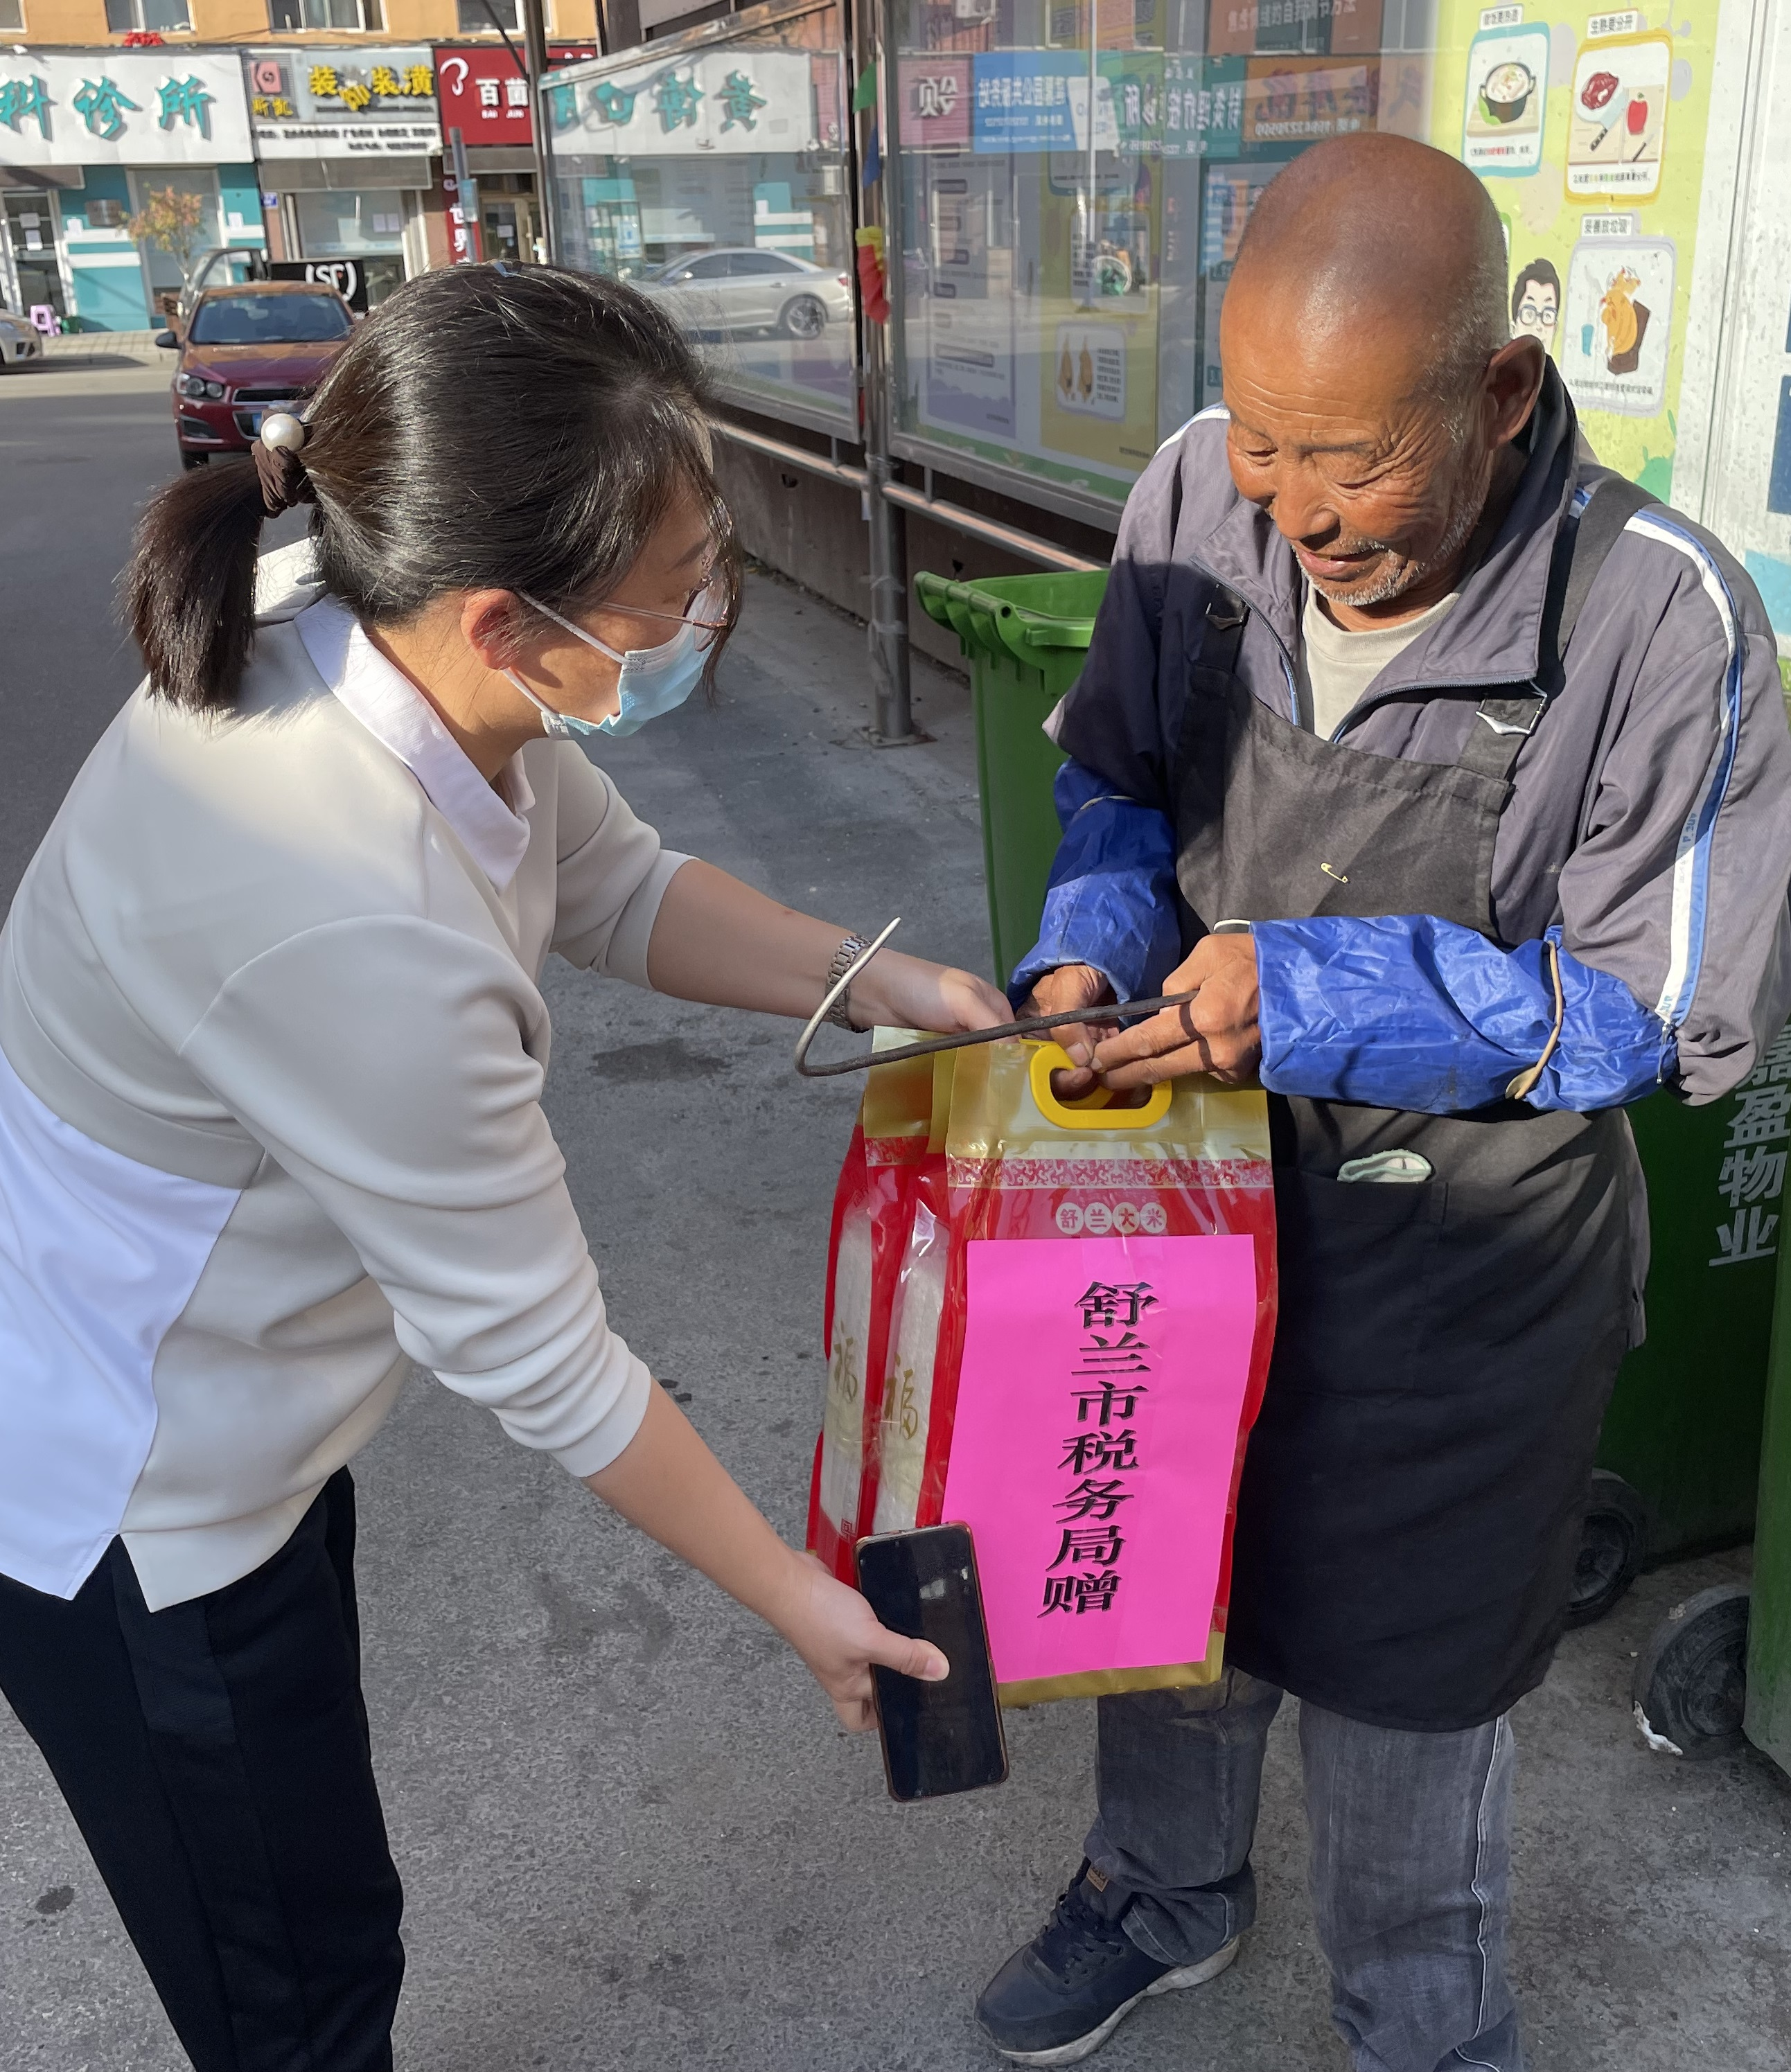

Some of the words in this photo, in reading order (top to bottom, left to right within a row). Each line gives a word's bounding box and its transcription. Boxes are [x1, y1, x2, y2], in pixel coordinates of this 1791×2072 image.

[0, 73, 212, 140] 科诊所
[1059, 1206, 1164, 1229] 舒兰大米
[1037, 1280, 1159, 1619] 舒兰市税务局赠
